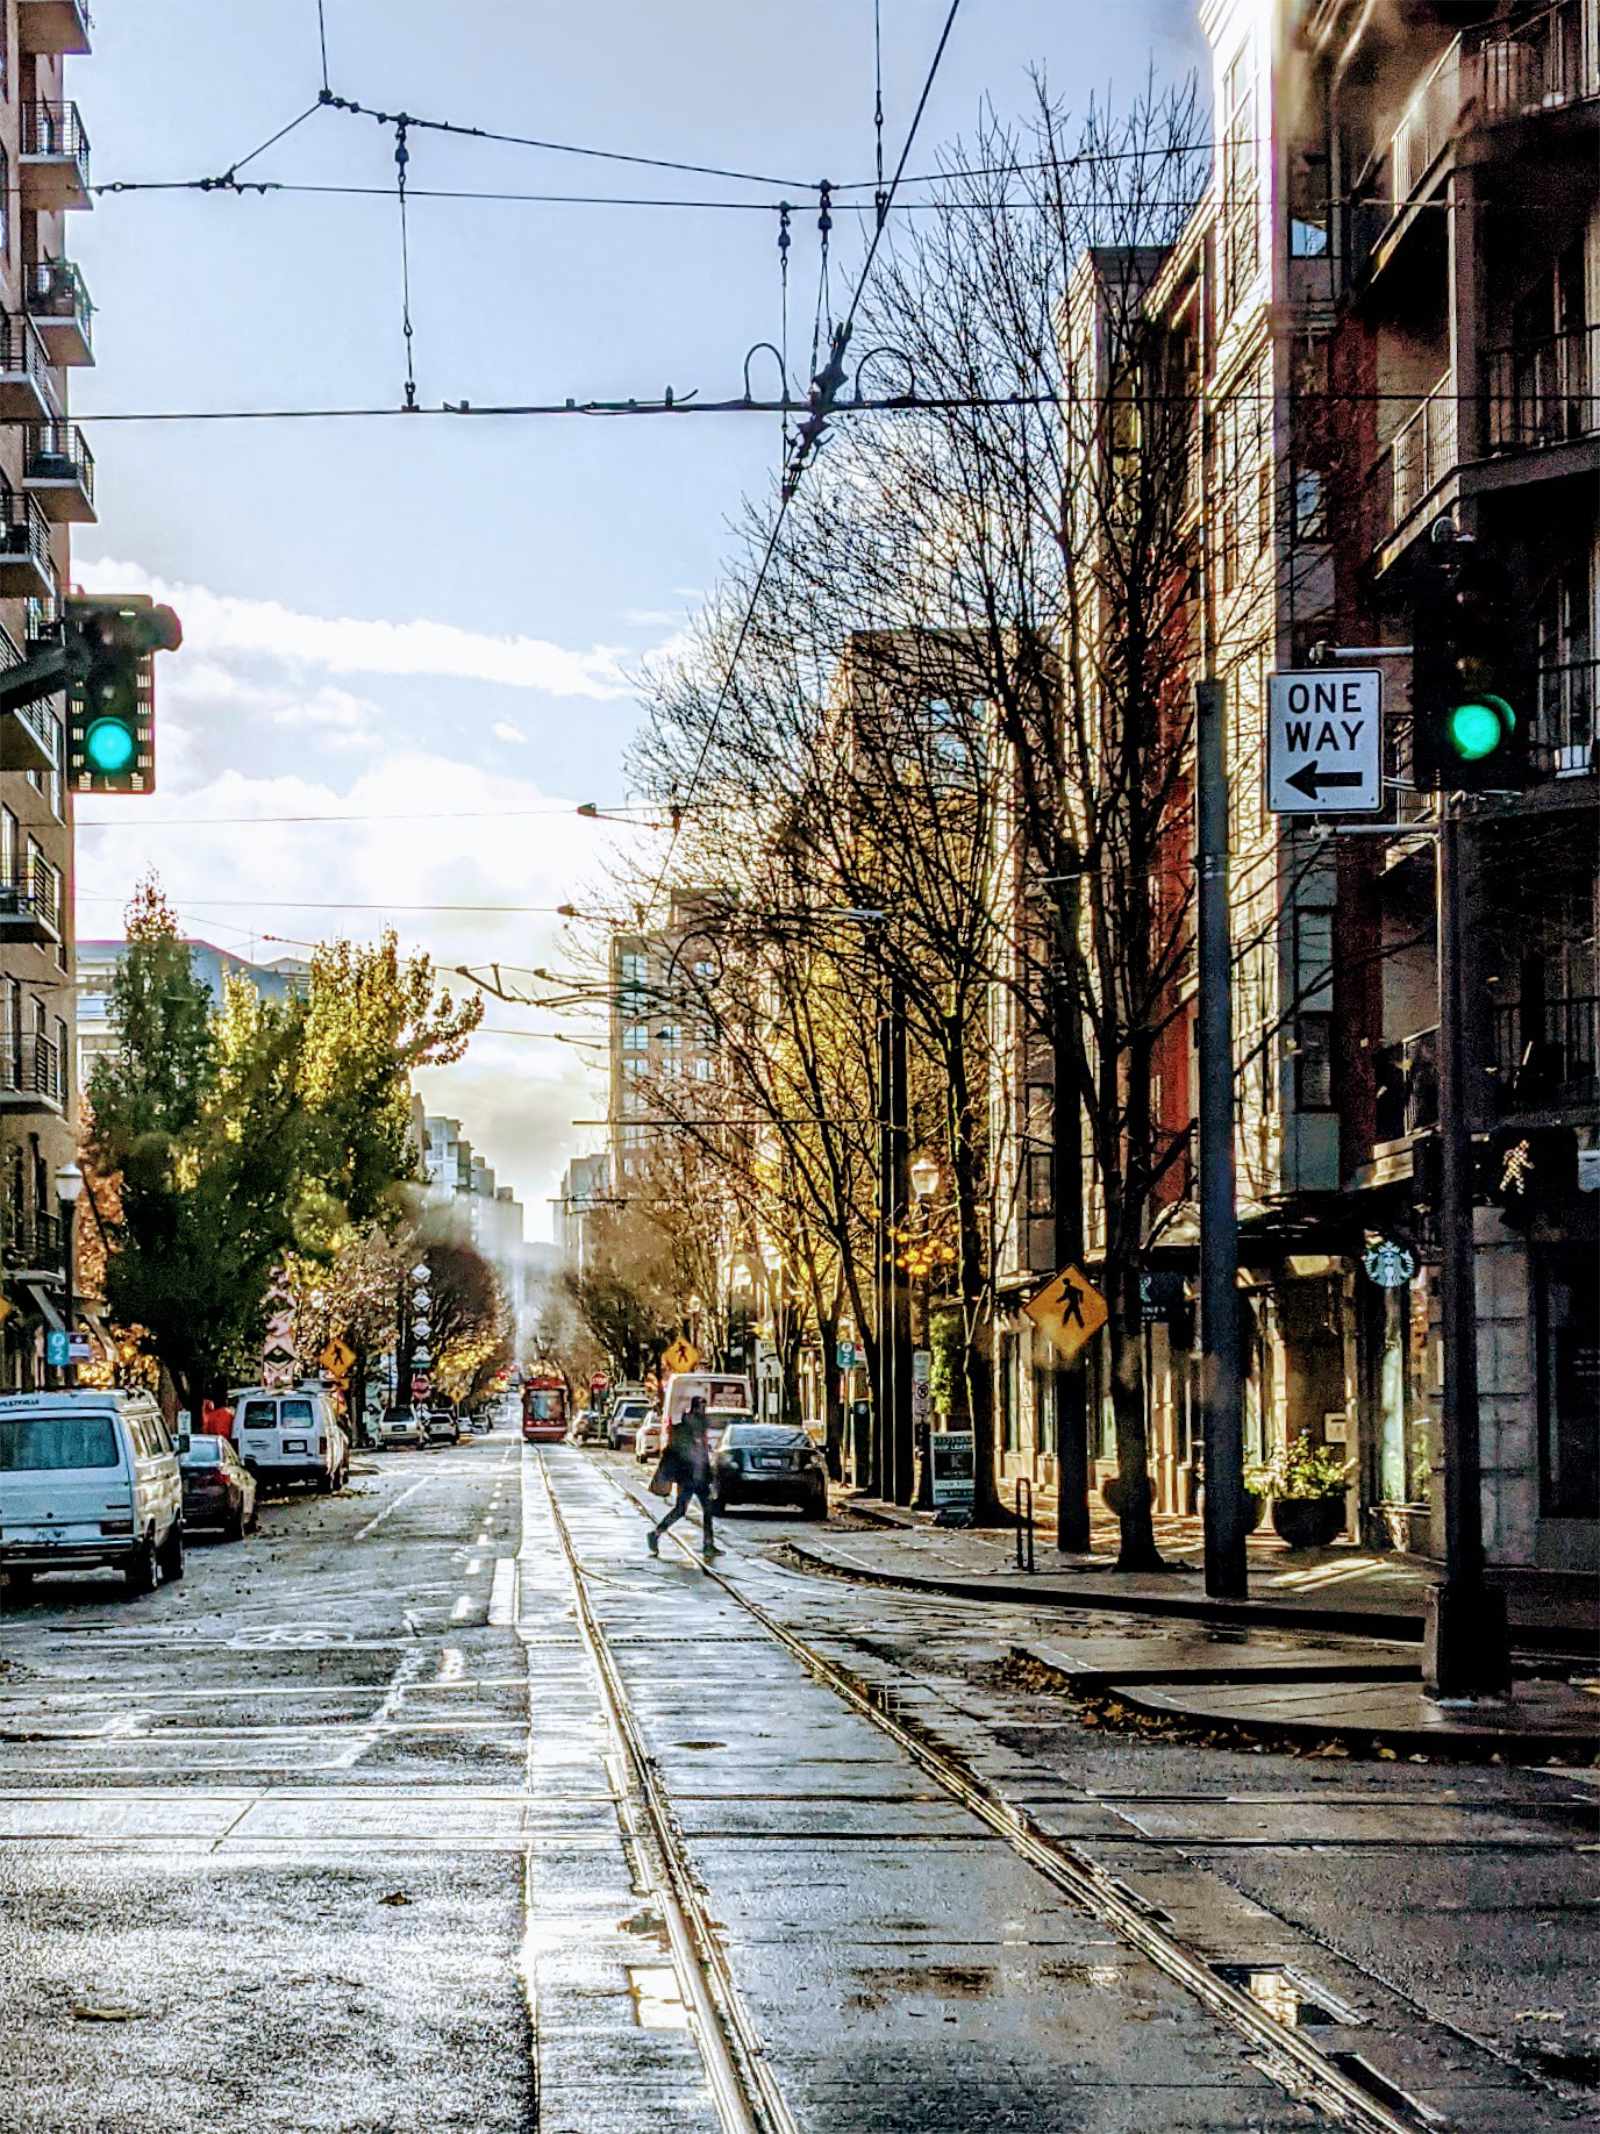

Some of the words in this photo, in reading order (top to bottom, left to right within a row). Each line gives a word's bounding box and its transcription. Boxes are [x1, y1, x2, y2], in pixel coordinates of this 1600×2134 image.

[1288, 683, 1361, 713] ONE
[1285, 720, 1364, 752] WAY
[843, 1353, 850, 1363] 2
